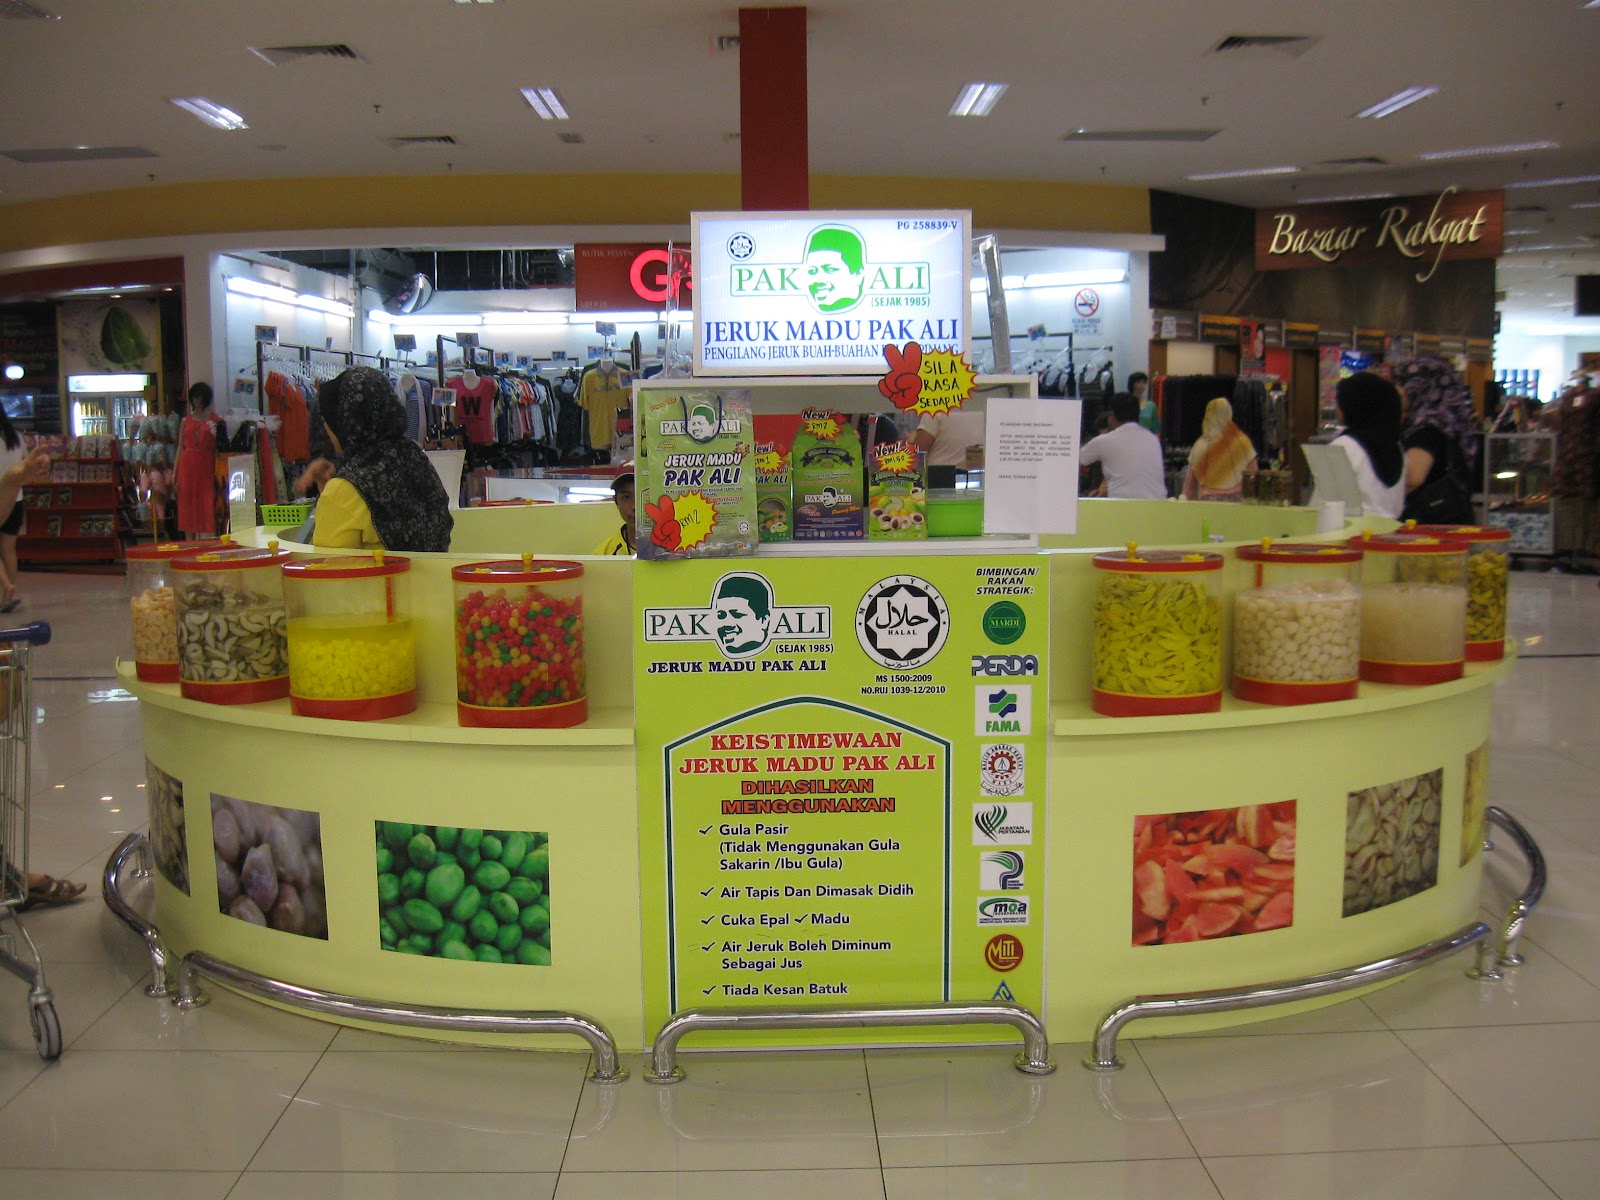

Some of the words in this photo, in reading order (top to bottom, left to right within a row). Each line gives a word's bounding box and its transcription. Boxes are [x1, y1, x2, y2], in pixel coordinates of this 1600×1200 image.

[897, 221, 910, 230] PG
[913, 221, 958, 230] 258839-V
[1269, 213, 1367, 263] Bazaar
[1375, 185, 1488, 283] Rakyat
[735, 267, 802, 292] PAK
[870, 266, 926, 290] ALI
[871, 297, 902, 307] (SEJAK
[904, 297, 930, 307] 1985)
[705, 320, 780, 346] JERUK
[786, 320, 862, 341] MADU
[869, 320, 916, 340] PAK
[919, 319, 958, 340] ALI
[705, 345, 766, 360] PENGILANG
[767, 345, 801, 361] JERUK
[803, 344, 879, 358] BUAH-BUAHAN
[923, 360, 957, 375] SILA
[923, 378, 960, 392] RASA
[461, 396, 482, 416] W
[920, 397, 950, 409] SEDAP
[802, 410, 831, 420] New!
[754, 442, 773, 453] ew!
[664, 454, 705, 468] JERUK
[706, 452, 742, 466] MADU
[663, 468, 705, 487] PAK
[708, 467, 742, 485] ALI
[773, 474, 788, 484] ALI
[987, 577, 1024, 585] RAKAN
[859, 577, 946, 615] MALAYSIA
[976, 587, 1034, 595] STRATEGIK:
[875, 600, 929, 629] حلال
[650, 613, 711, 637] PAK
[773, 612, 826, 635] ALI
[775, 644, 806, 654] (SEJAK
[808, 643, 834, 654] 1985)
[648, 661, 703, 673] JERUK
[709, 661, 756, 673] MADU
[762, 660, 794, 672] PAK
[799, 660, 827, 671] ALI
[861, 686, 888, 694] NO.RUJ
[891, 686, 946, 694] 1039-12/2010
[986, 720, 1021, 733] FAMA
[710, 731, 902, 752] KEISTIMEWAAN
[679, 758, 759, 774] JERUK
[766, 756, 834, 772] MADU
[842, 755, 889, 771] PAK
[895, 755, 935, 770] ALI
[741, 779, 874, 795] DIHASILKAN
[721, 797, 896, 814] MENGGUNAKAN
[719, 824, 752, 836] Gula
[755, 823, 789, 836] Pasir
[719, 840, 762, 855] (Tidak
[766, 840, 864, 856] Menggunakan
[868, 839, 900, 852] Gula
[720, 858, 770, 871] Sakarin
[774, 857, 803, 871] /Ibu
[806, 857, 843, 871] Gula)
[721, 887, 741, 898] Air
[745, 886, 780, 902] Tapis
[784, 886, 811, 898] Dan
[815, 885, 873, 897] Dimasak
[877, 884, 914, 896] Didih
[993, 902, 1027, 913] moa
[721, 914, 756, 926] Cuka
[759, 914, 790, 930] Epal
[811, 913, 850, 925] Madu
[721, 941, 742, 953] Air
[745, 941, 785, 953] Jeruk
[788, 940, 827, 952] Boleh
[831, 939, 892, 951] Diminum
[722, 958, 776, 973] Sebagai
[780, 958, 803, 970] Jus
[722, 984, 760, 996] Tiada
[763, 984, 805, 996] Kesan
[808, 983, 849, 995] Batuk
